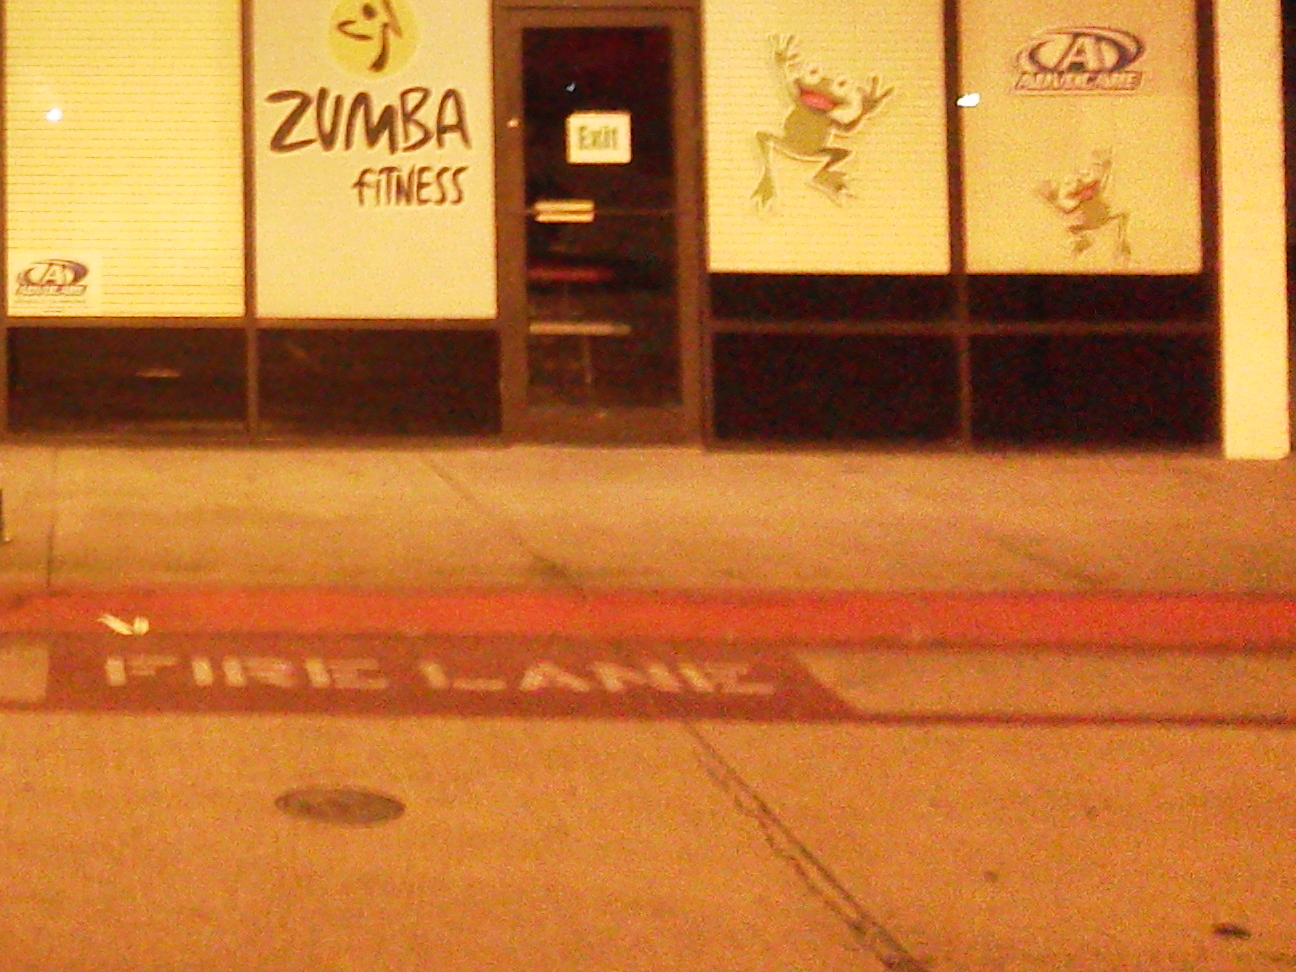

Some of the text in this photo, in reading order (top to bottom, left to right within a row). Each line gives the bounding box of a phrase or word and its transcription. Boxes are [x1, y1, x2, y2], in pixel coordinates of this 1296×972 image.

[265, 86, 473, 155] ZUMBA
[106, 655, 776, 695] FIRE LANE
